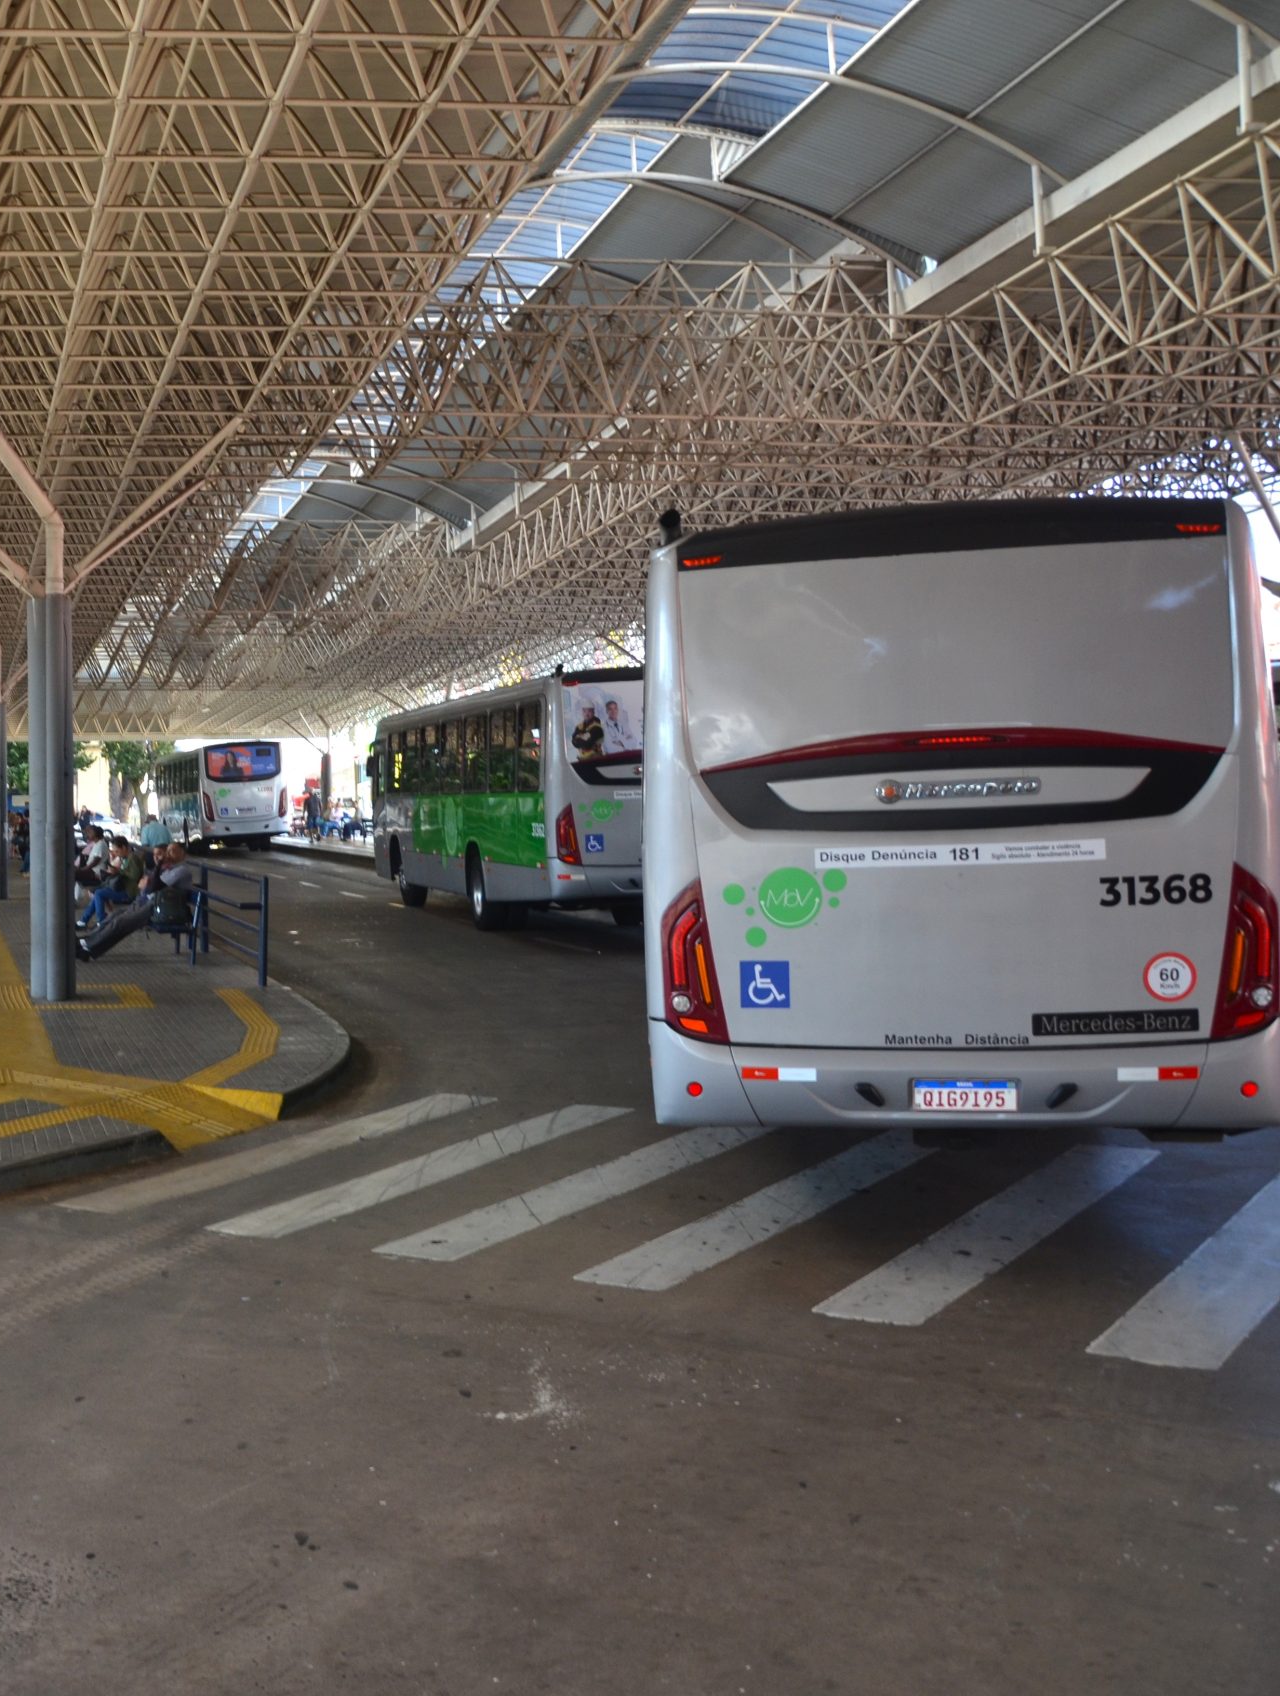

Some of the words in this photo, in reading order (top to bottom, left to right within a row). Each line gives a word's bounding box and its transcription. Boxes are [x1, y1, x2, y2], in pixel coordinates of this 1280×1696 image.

[819, 850, 866, 864] Disque
[871, 848, 937, 862] Denúncia
[948, 847, 981, 862] 181
[1099, 872, 1213, 907] 31368
[1159, 967, 1180, 982] 60
[1040, 1012, 1191, 1034] Mercedes-Benz
[884, 1033, 953, 1045] Mantenha
[964, 1032, 1030, 1045] Distância
